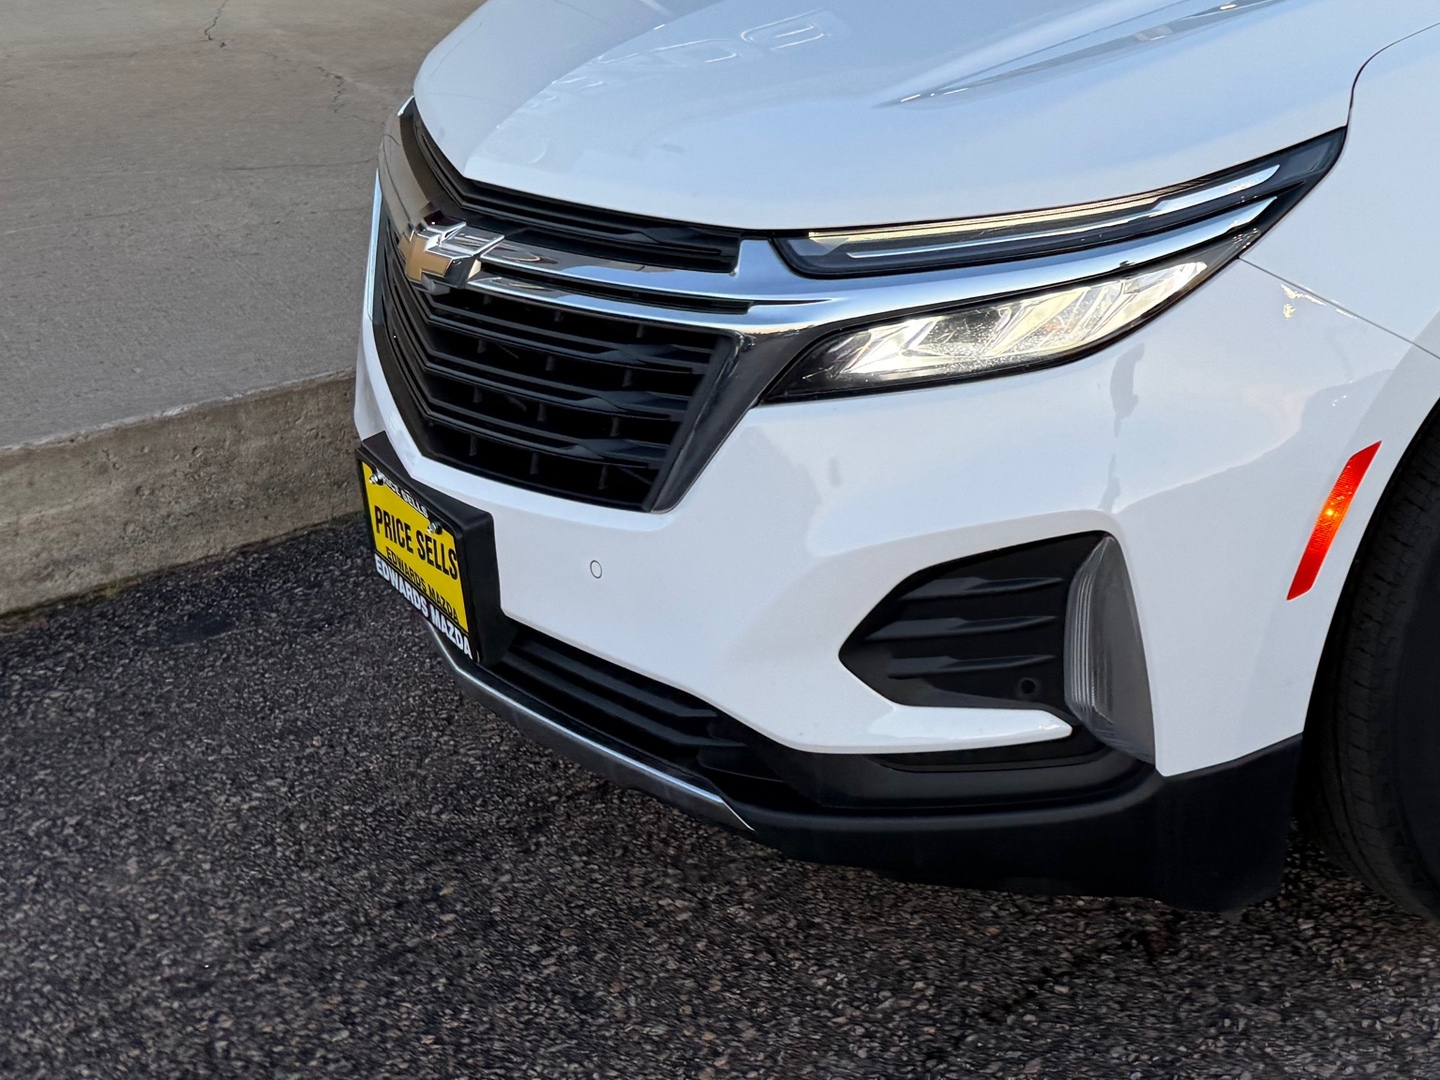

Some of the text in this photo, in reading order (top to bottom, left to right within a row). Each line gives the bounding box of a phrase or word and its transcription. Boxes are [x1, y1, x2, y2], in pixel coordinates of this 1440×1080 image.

[374, 505, 458, 580] PRICE SELLS
[374, 553, 473, 660] EDWARDS MAZDA
[385, 546, 459, 623] EDWARDS MAZDA
